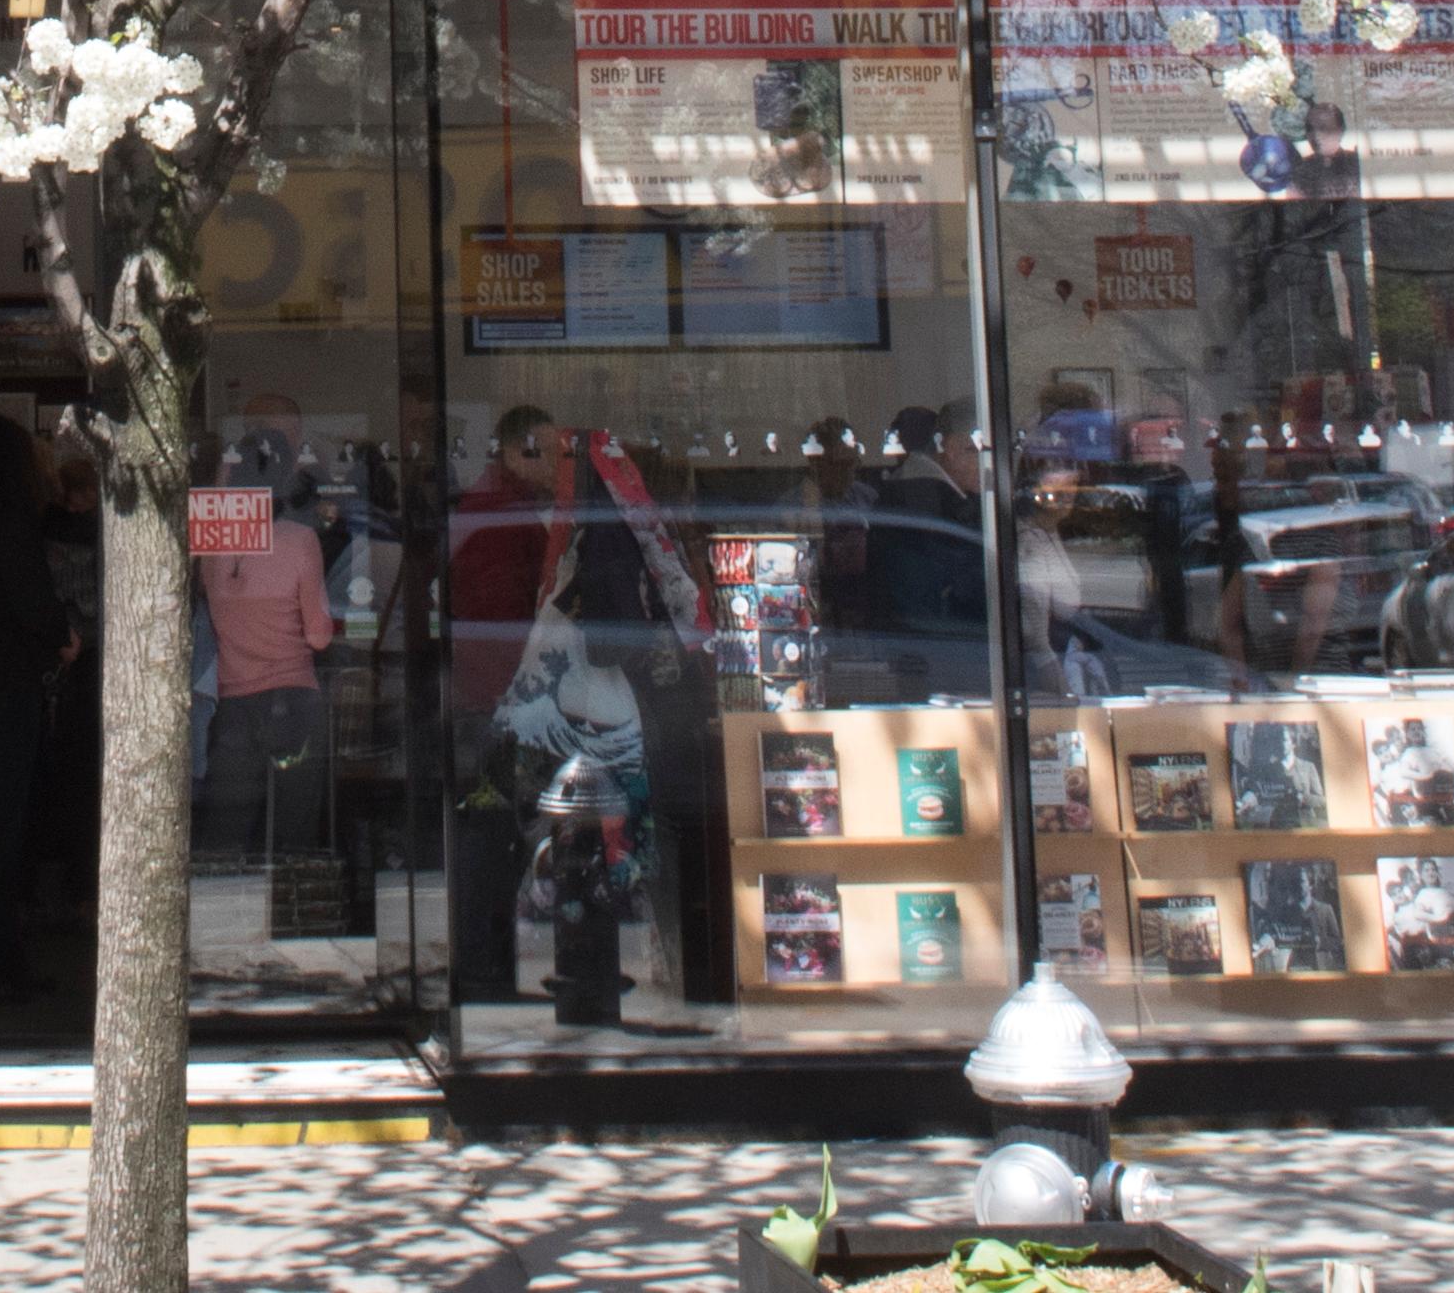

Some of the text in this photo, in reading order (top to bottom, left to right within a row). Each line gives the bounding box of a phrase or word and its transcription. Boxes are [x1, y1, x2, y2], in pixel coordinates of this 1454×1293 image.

[580, 13, 815, 46] TOUR THE BUILDING
[834, 12, 908, 44] WALK
[591, 66, 666, 84] SHOP LIFE
[852, 65, 943, 83] SWEATSHOP
[1362, 61, 1402, 78] IRISH
[480, 254, 540, 281] SHOP
[1117, 247, 1175, 272] TOUR
[476, 281, 546, 307] SALES
[1101, 274, 1193, 301] TICKETS
[188, 492, 271, 521] NEMENT
[188, 520, 268, 550] USEUM
